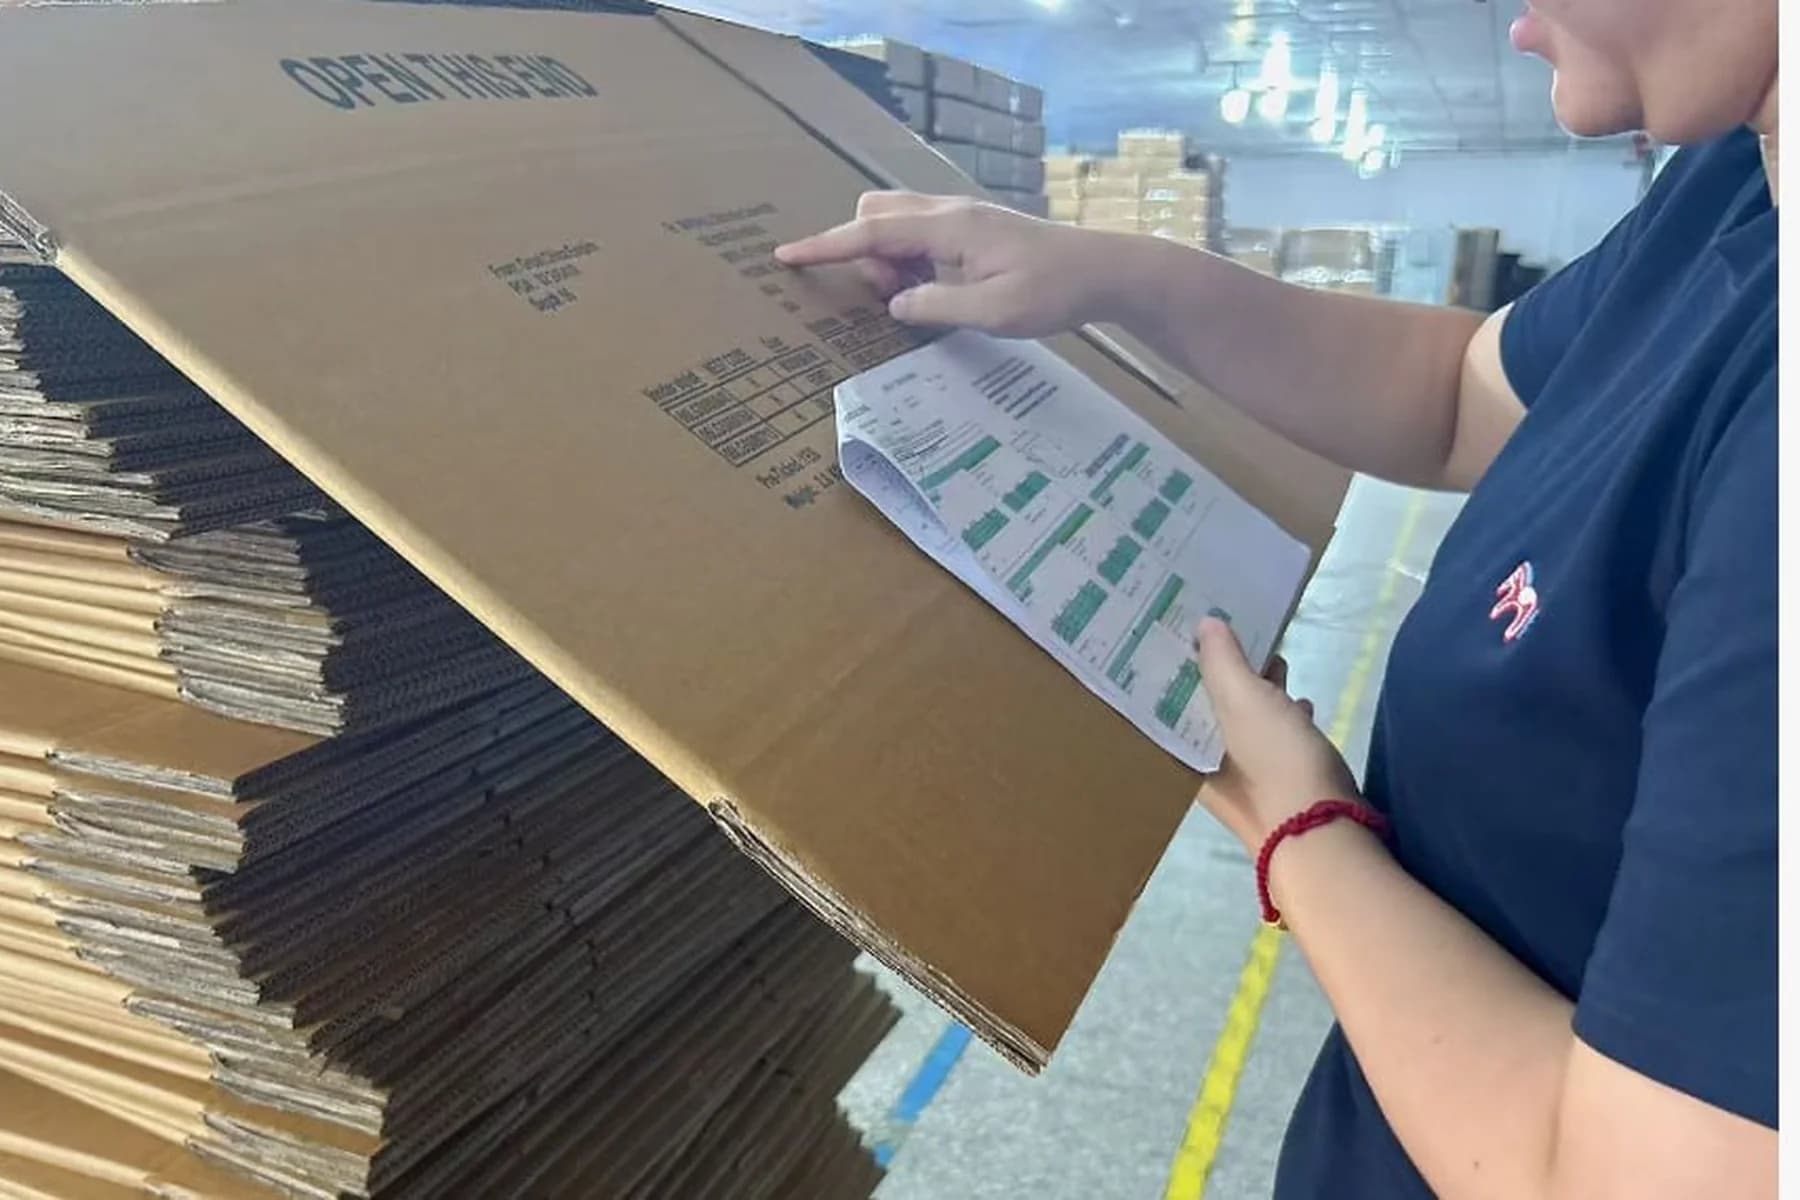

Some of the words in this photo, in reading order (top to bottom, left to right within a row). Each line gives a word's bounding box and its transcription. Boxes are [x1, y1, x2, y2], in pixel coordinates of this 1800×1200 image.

[280, 53, 447, 110] OPEN
[402, 53, 532, 99] THIS
[493, 54, 599, 98] END
